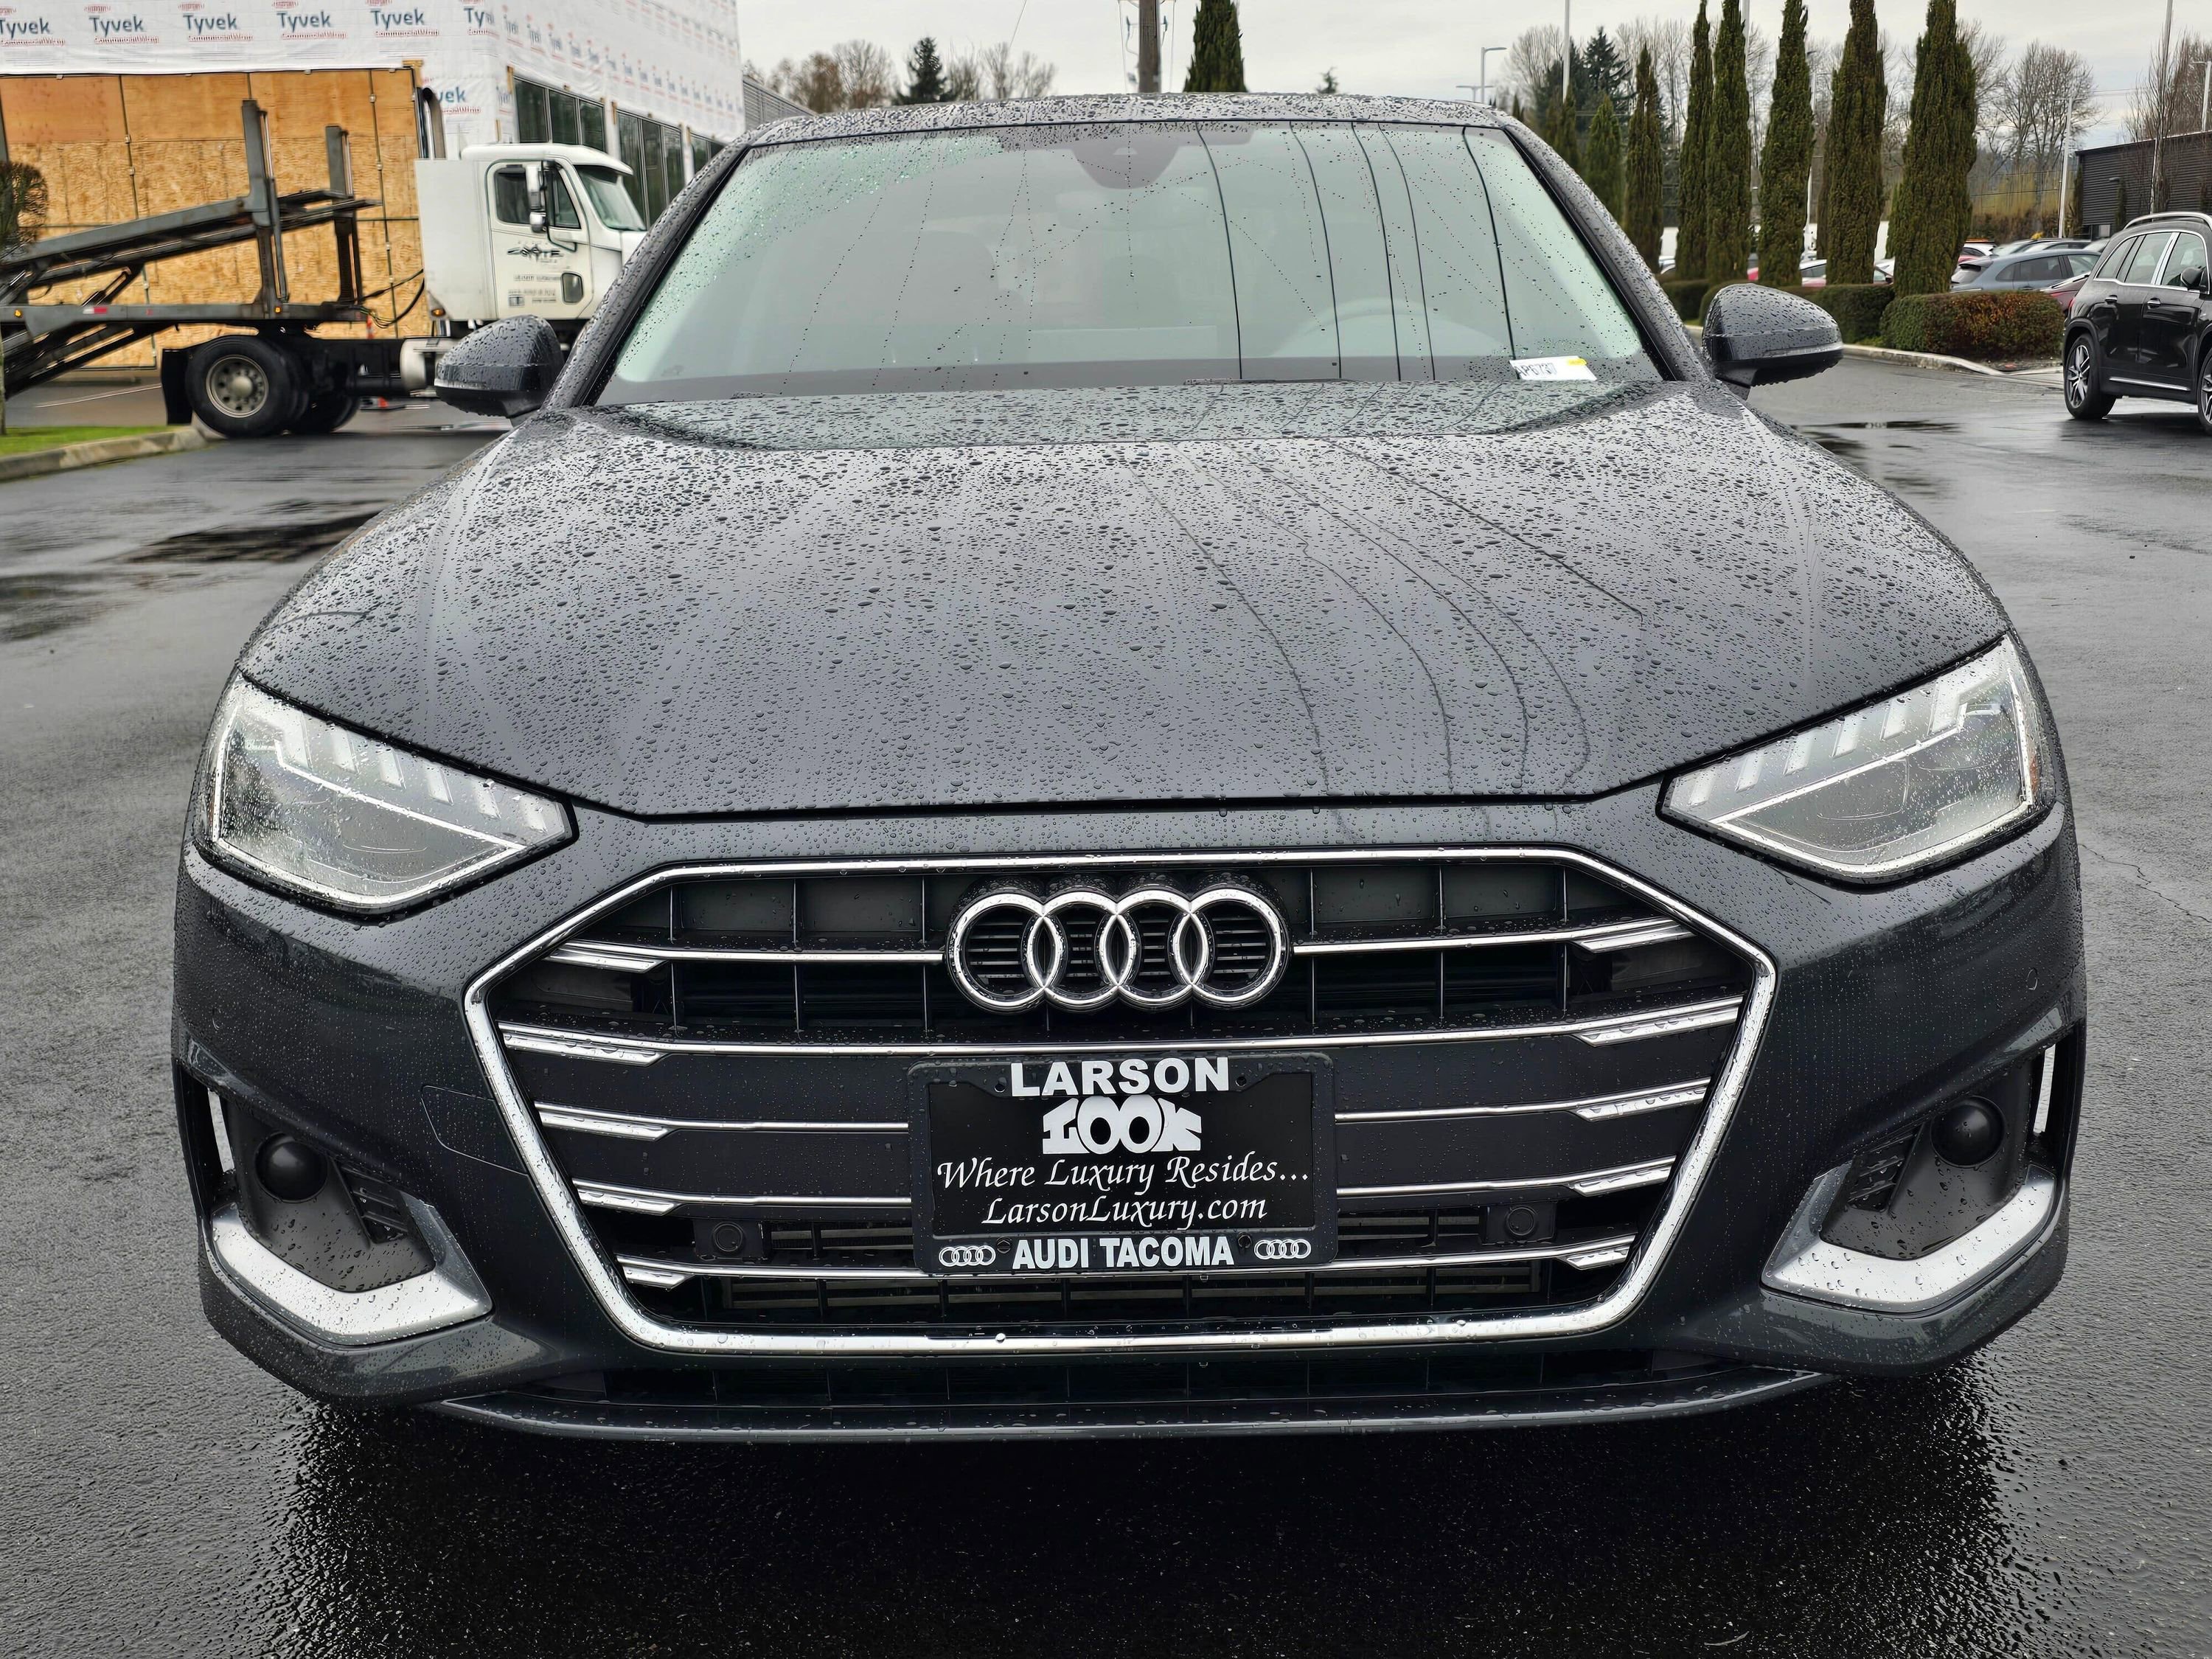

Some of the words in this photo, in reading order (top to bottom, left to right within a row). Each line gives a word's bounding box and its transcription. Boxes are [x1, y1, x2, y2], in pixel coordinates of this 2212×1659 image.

[88, 14, 145, 37] Tyvek
[183, 12, 237, 35] Tyvek
[277, 10, 332, 32] Tyvek
[370, 8, 425, 30] Tyvek
[1011, 1057, 1229, 1096] LARSON
[937, 1157, 1035, 1189] Where
[1043, 1159, 1155, 1196] Luxury
[1165, 1150, 1310, 1189] Resides...
[981, 1196, 1267, 1231] LarsonLuxury.com
[1012, 1238, 1089, 1270] AUDI
[1099, 1236, 1235, 1267] TACOMA
